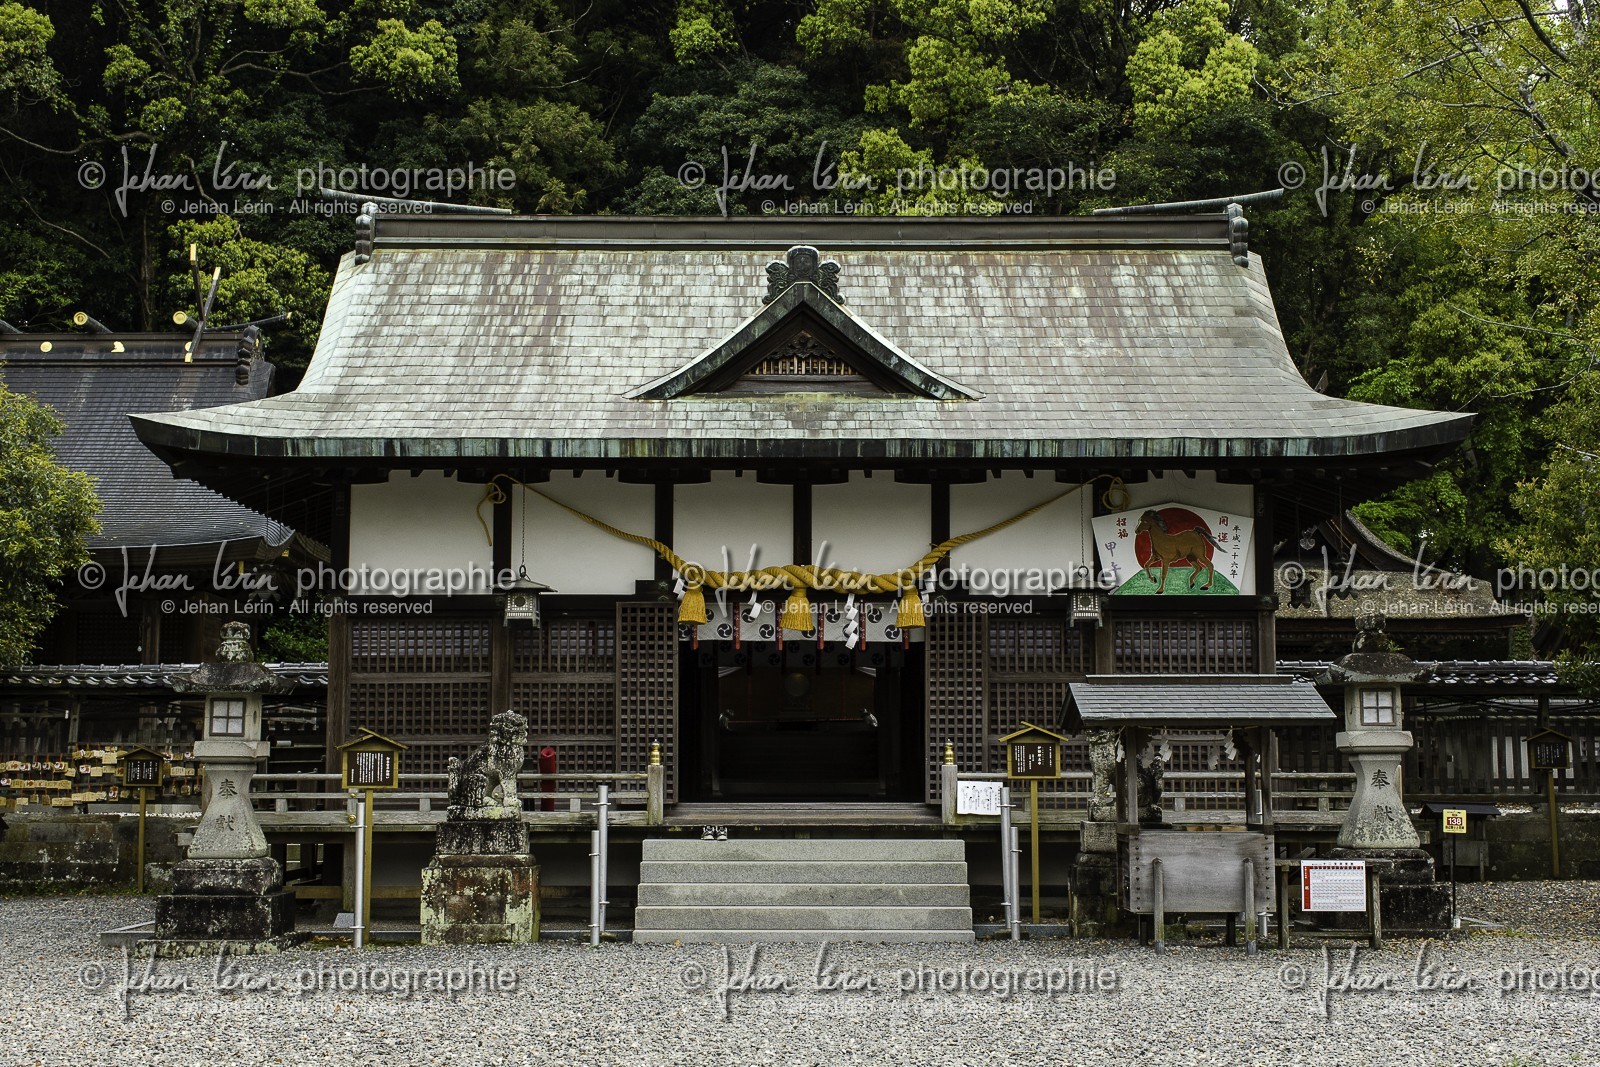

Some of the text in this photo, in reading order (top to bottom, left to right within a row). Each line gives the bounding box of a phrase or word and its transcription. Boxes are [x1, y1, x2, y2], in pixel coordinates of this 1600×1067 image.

[1116, 517, 1128, 539] 招福
[1218, 515, 1229, 543] 開運
[1229, 525, 1241, 579] 平成二十六年
[1448, 817, 1461, 825] 138
